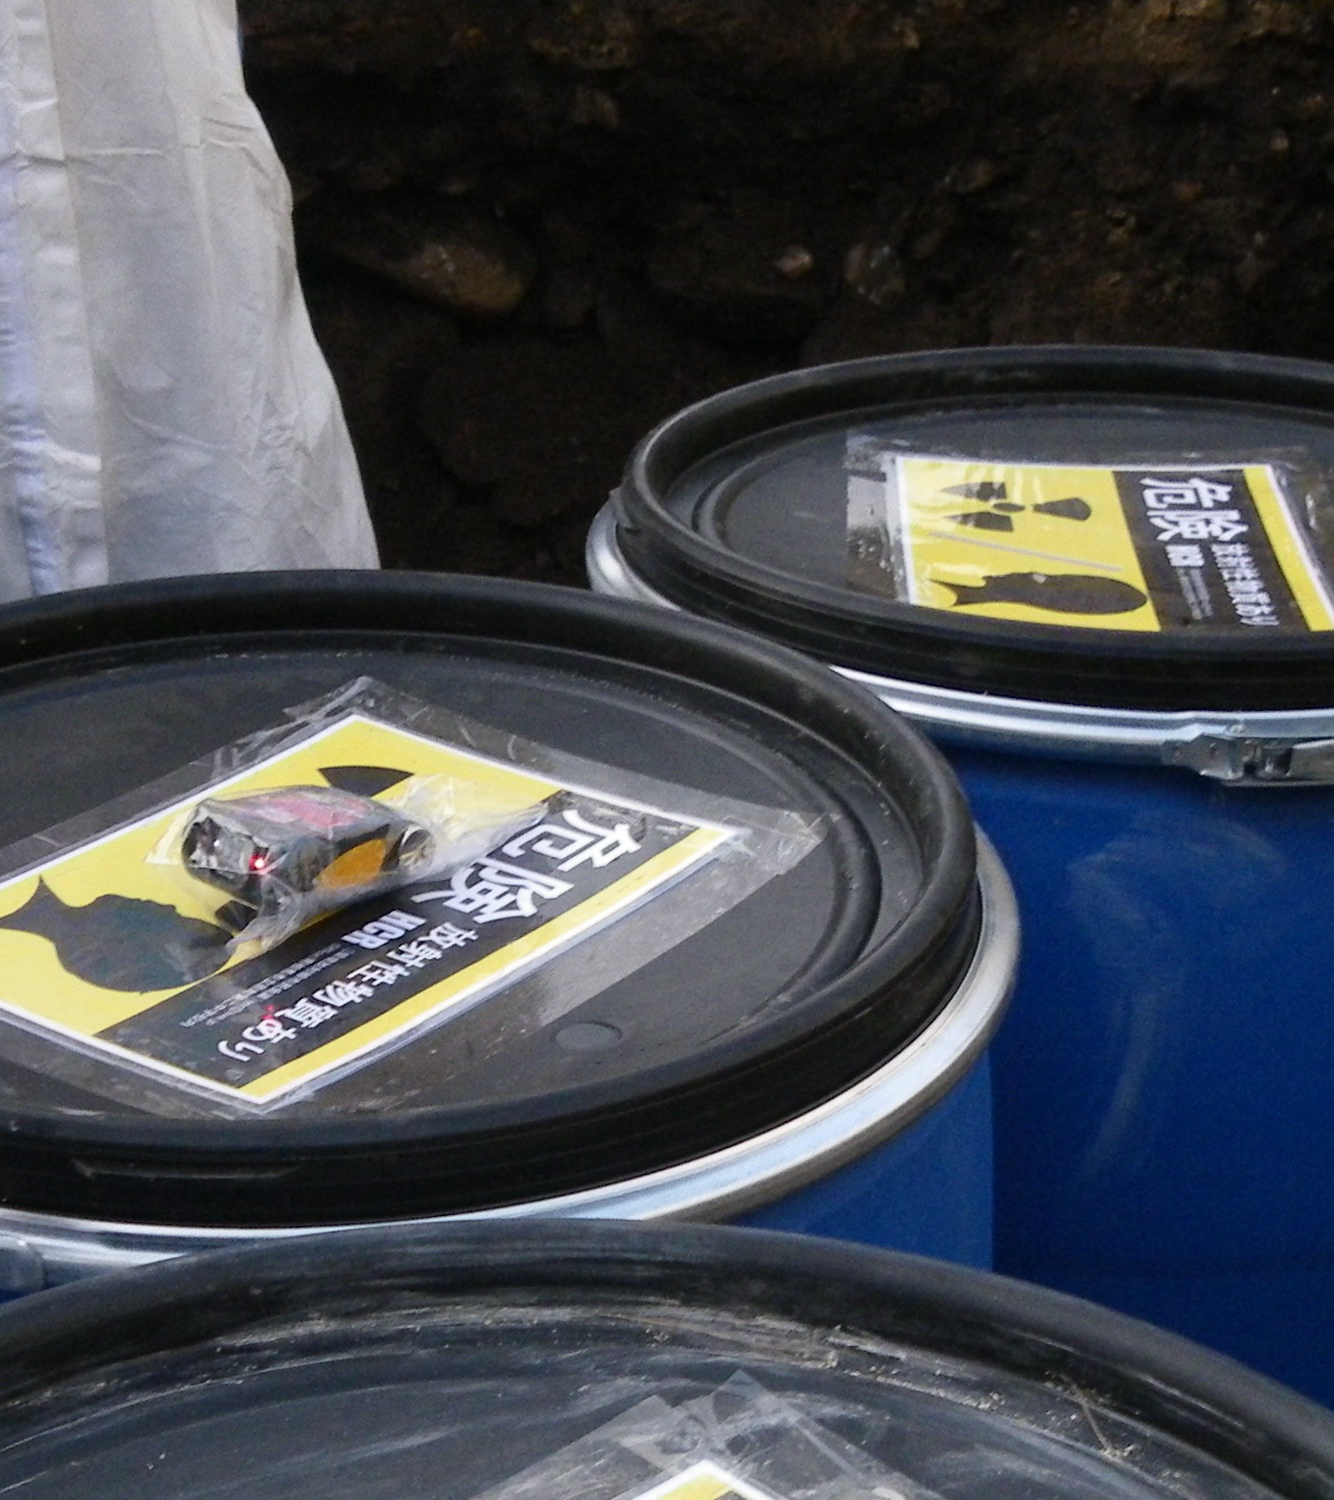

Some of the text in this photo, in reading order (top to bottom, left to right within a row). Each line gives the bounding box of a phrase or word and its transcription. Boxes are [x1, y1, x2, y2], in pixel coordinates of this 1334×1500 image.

[1139, 476, 1249, 541] 危険
[411, 809, 642, 924] 危険
[340, 909, 427, 950] HCR
[217, 921, 480, 1062] 放射性物質あり
